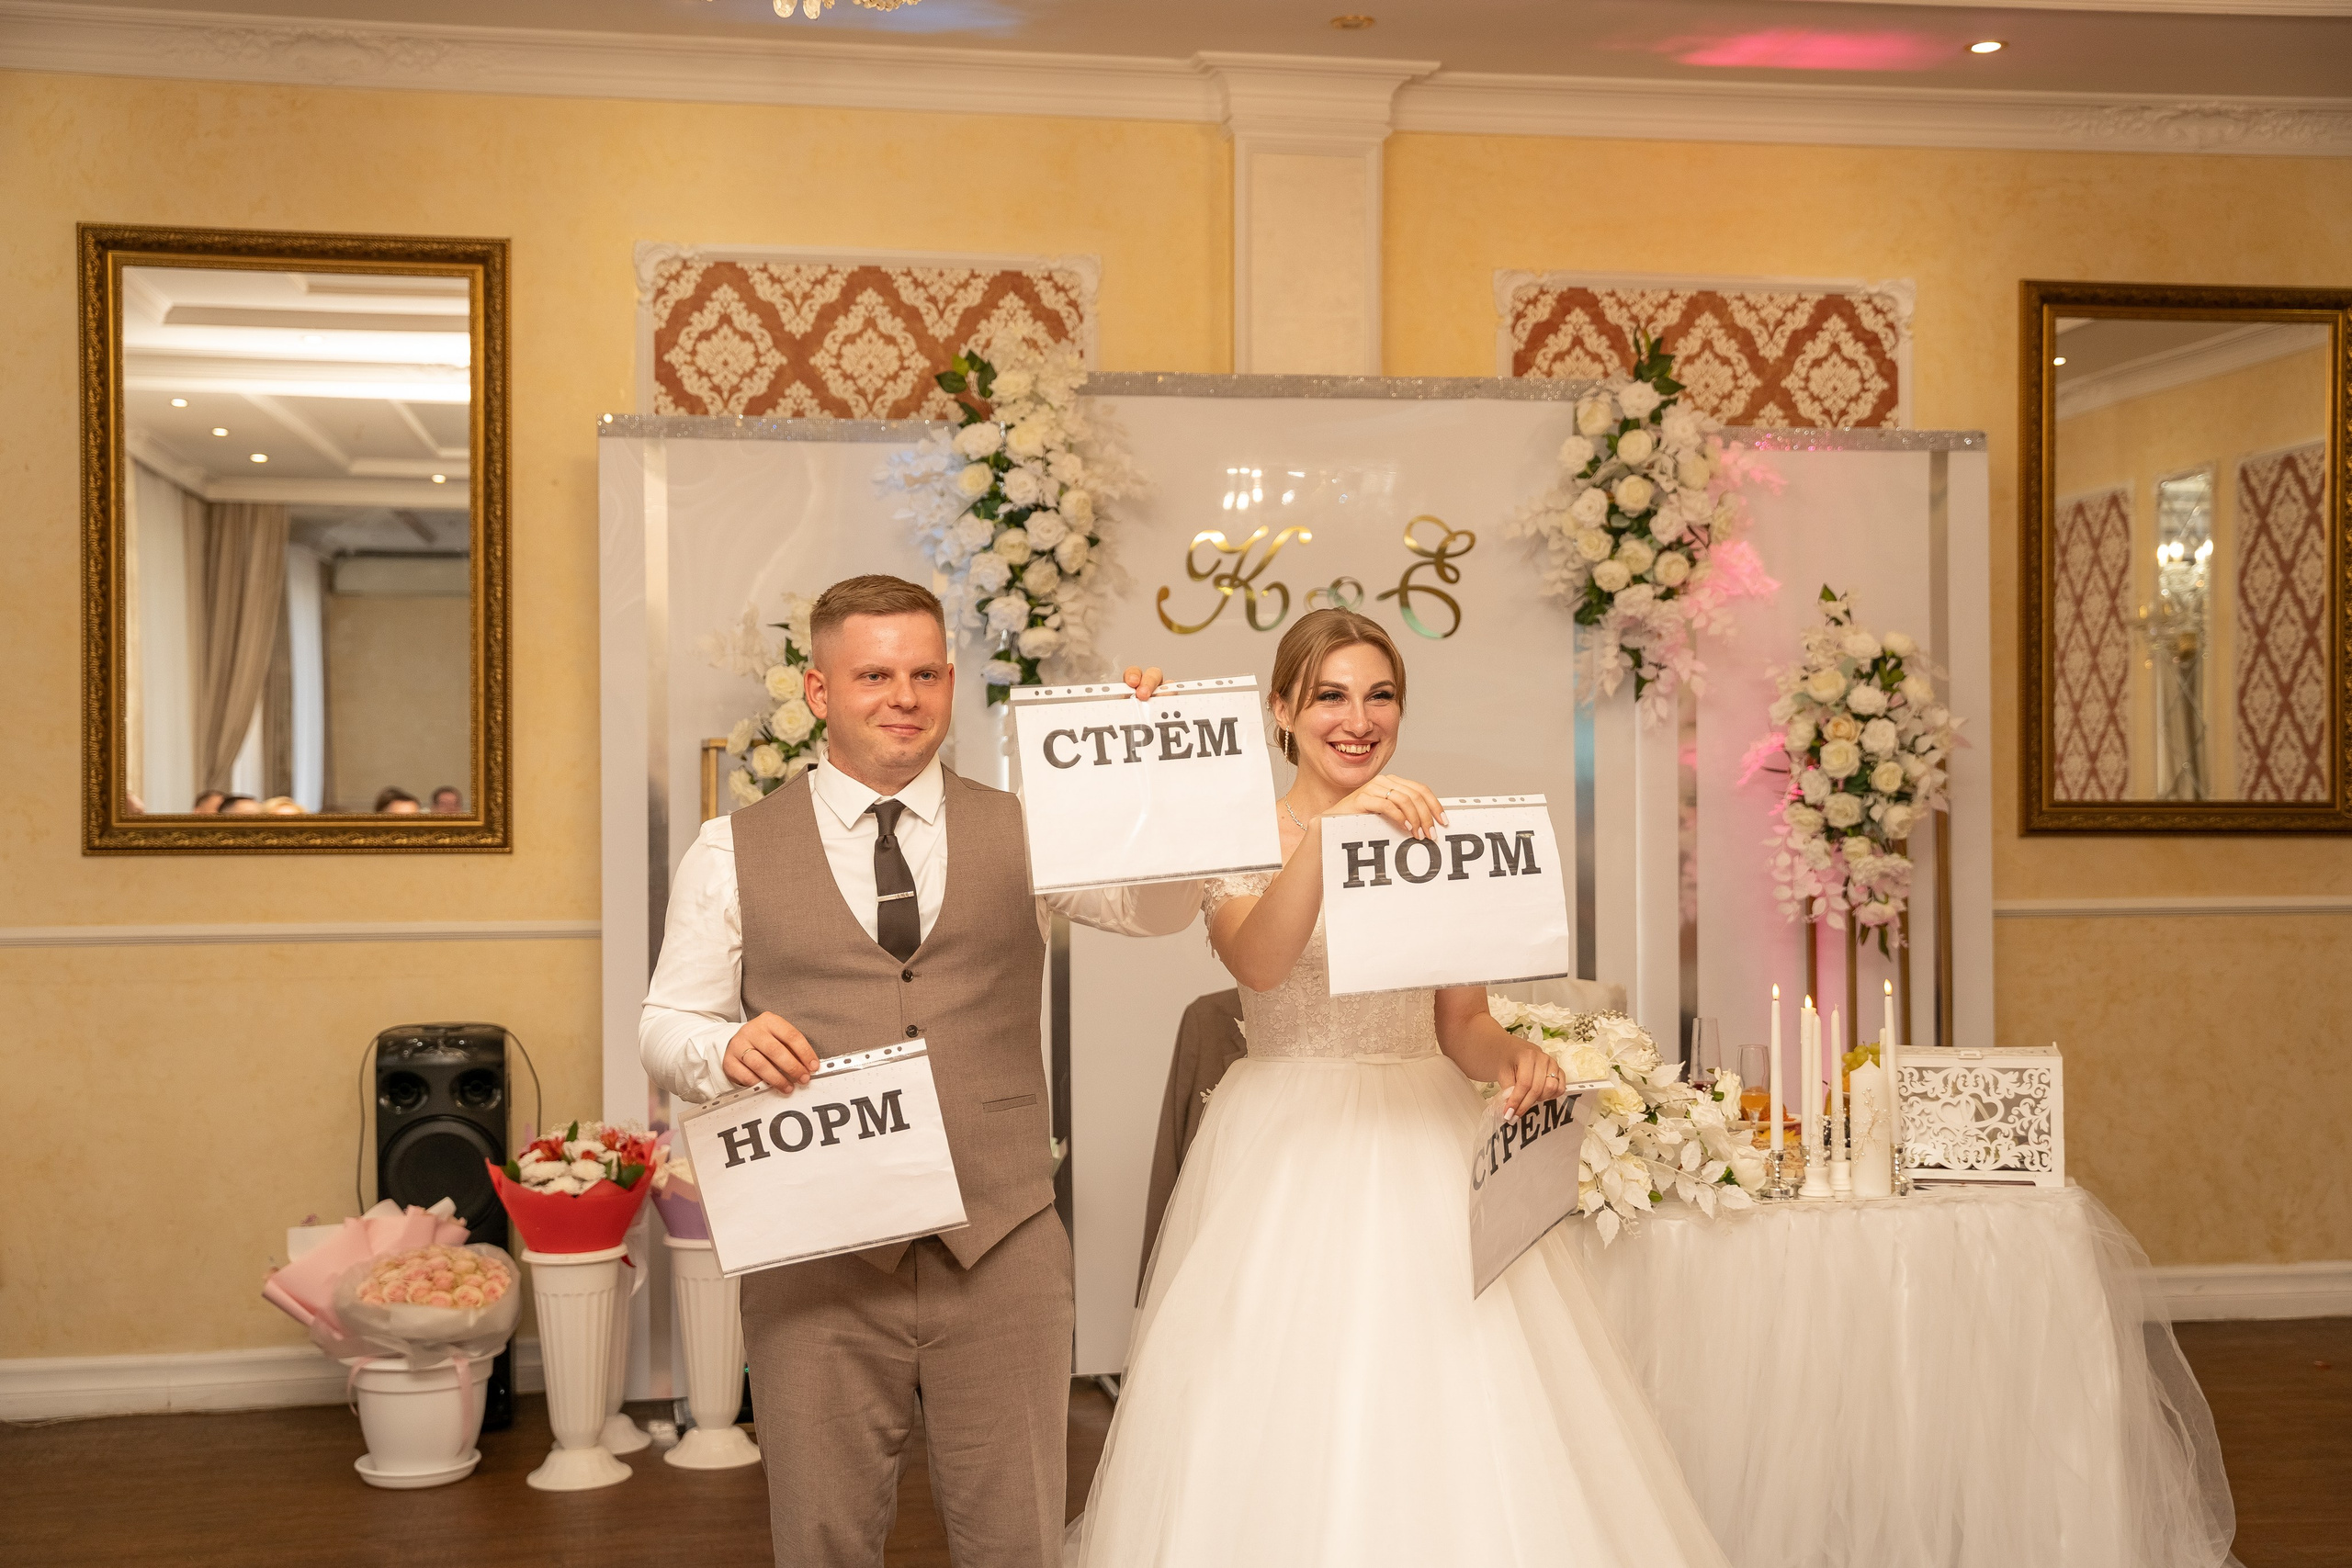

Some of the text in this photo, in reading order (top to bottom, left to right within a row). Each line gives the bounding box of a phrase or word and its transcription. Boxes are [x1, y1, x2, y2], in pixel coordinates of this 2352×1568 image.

[1042, 710, 1243, 770] СТРЁМ
[1341, 829, 1542, 889] НОРМ
[717, 1089, 911, 1168] НОРМ
